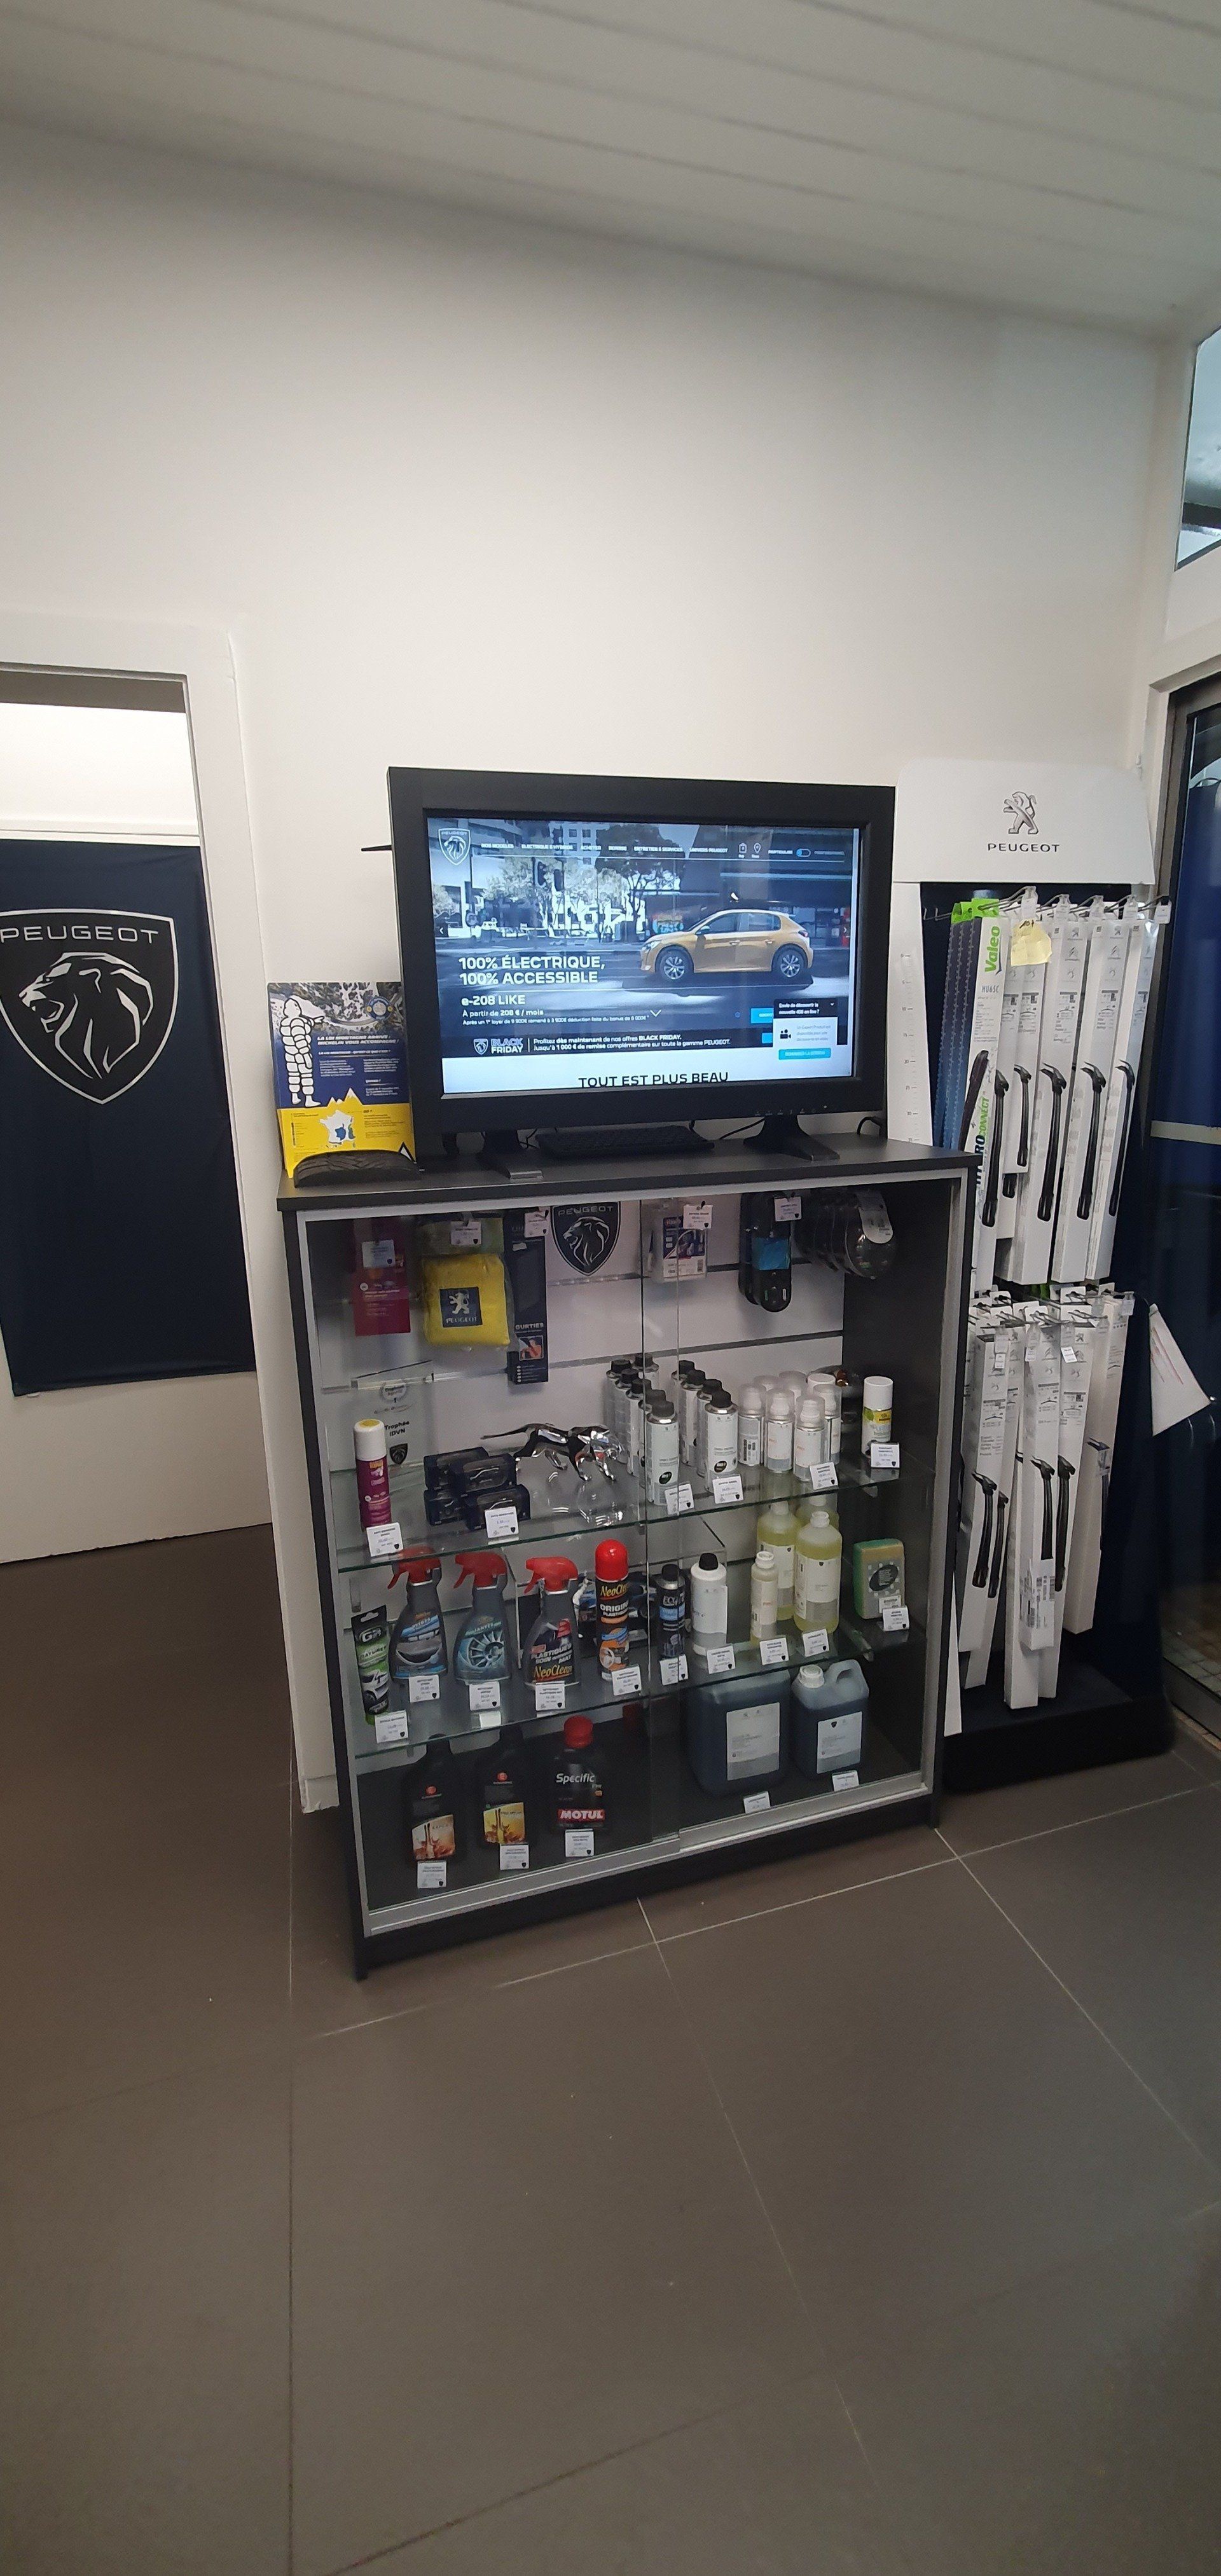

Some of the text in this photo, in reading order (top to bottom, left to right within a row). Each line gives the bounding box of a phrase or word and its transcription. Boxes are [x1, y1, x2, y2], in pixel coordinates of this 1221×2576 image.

[987, 843, 1060, 853] PEUGEOT
[1, 925, 158, 944] PEUGEOT
[984, 926, 1000, 972] Valeo
[458, 954, 605, 970] 100% ÉLECTRIQUE,
[459, 971, 598, 986] 100% ACCESSIBLE
[461, 995, 526, 1006] e-208 LIKE
[469, 1010, 489, 1018] partir
[490, 1038, 523, 1047] BLACK
[490, 1045, 523, 1054] FRIDAY
[578, 1071, 729, 1088] TOUT EST PLUS BEAU
[558, 1205, 614, 1216] PEUGEOT
[384, 1421, 410, 1430] Trophée
[534, 1664, 572, 1678] NeoClean
[556, 1773, 595, 1784] Specific
[560, 1810, 604, 1819] MOTUL
